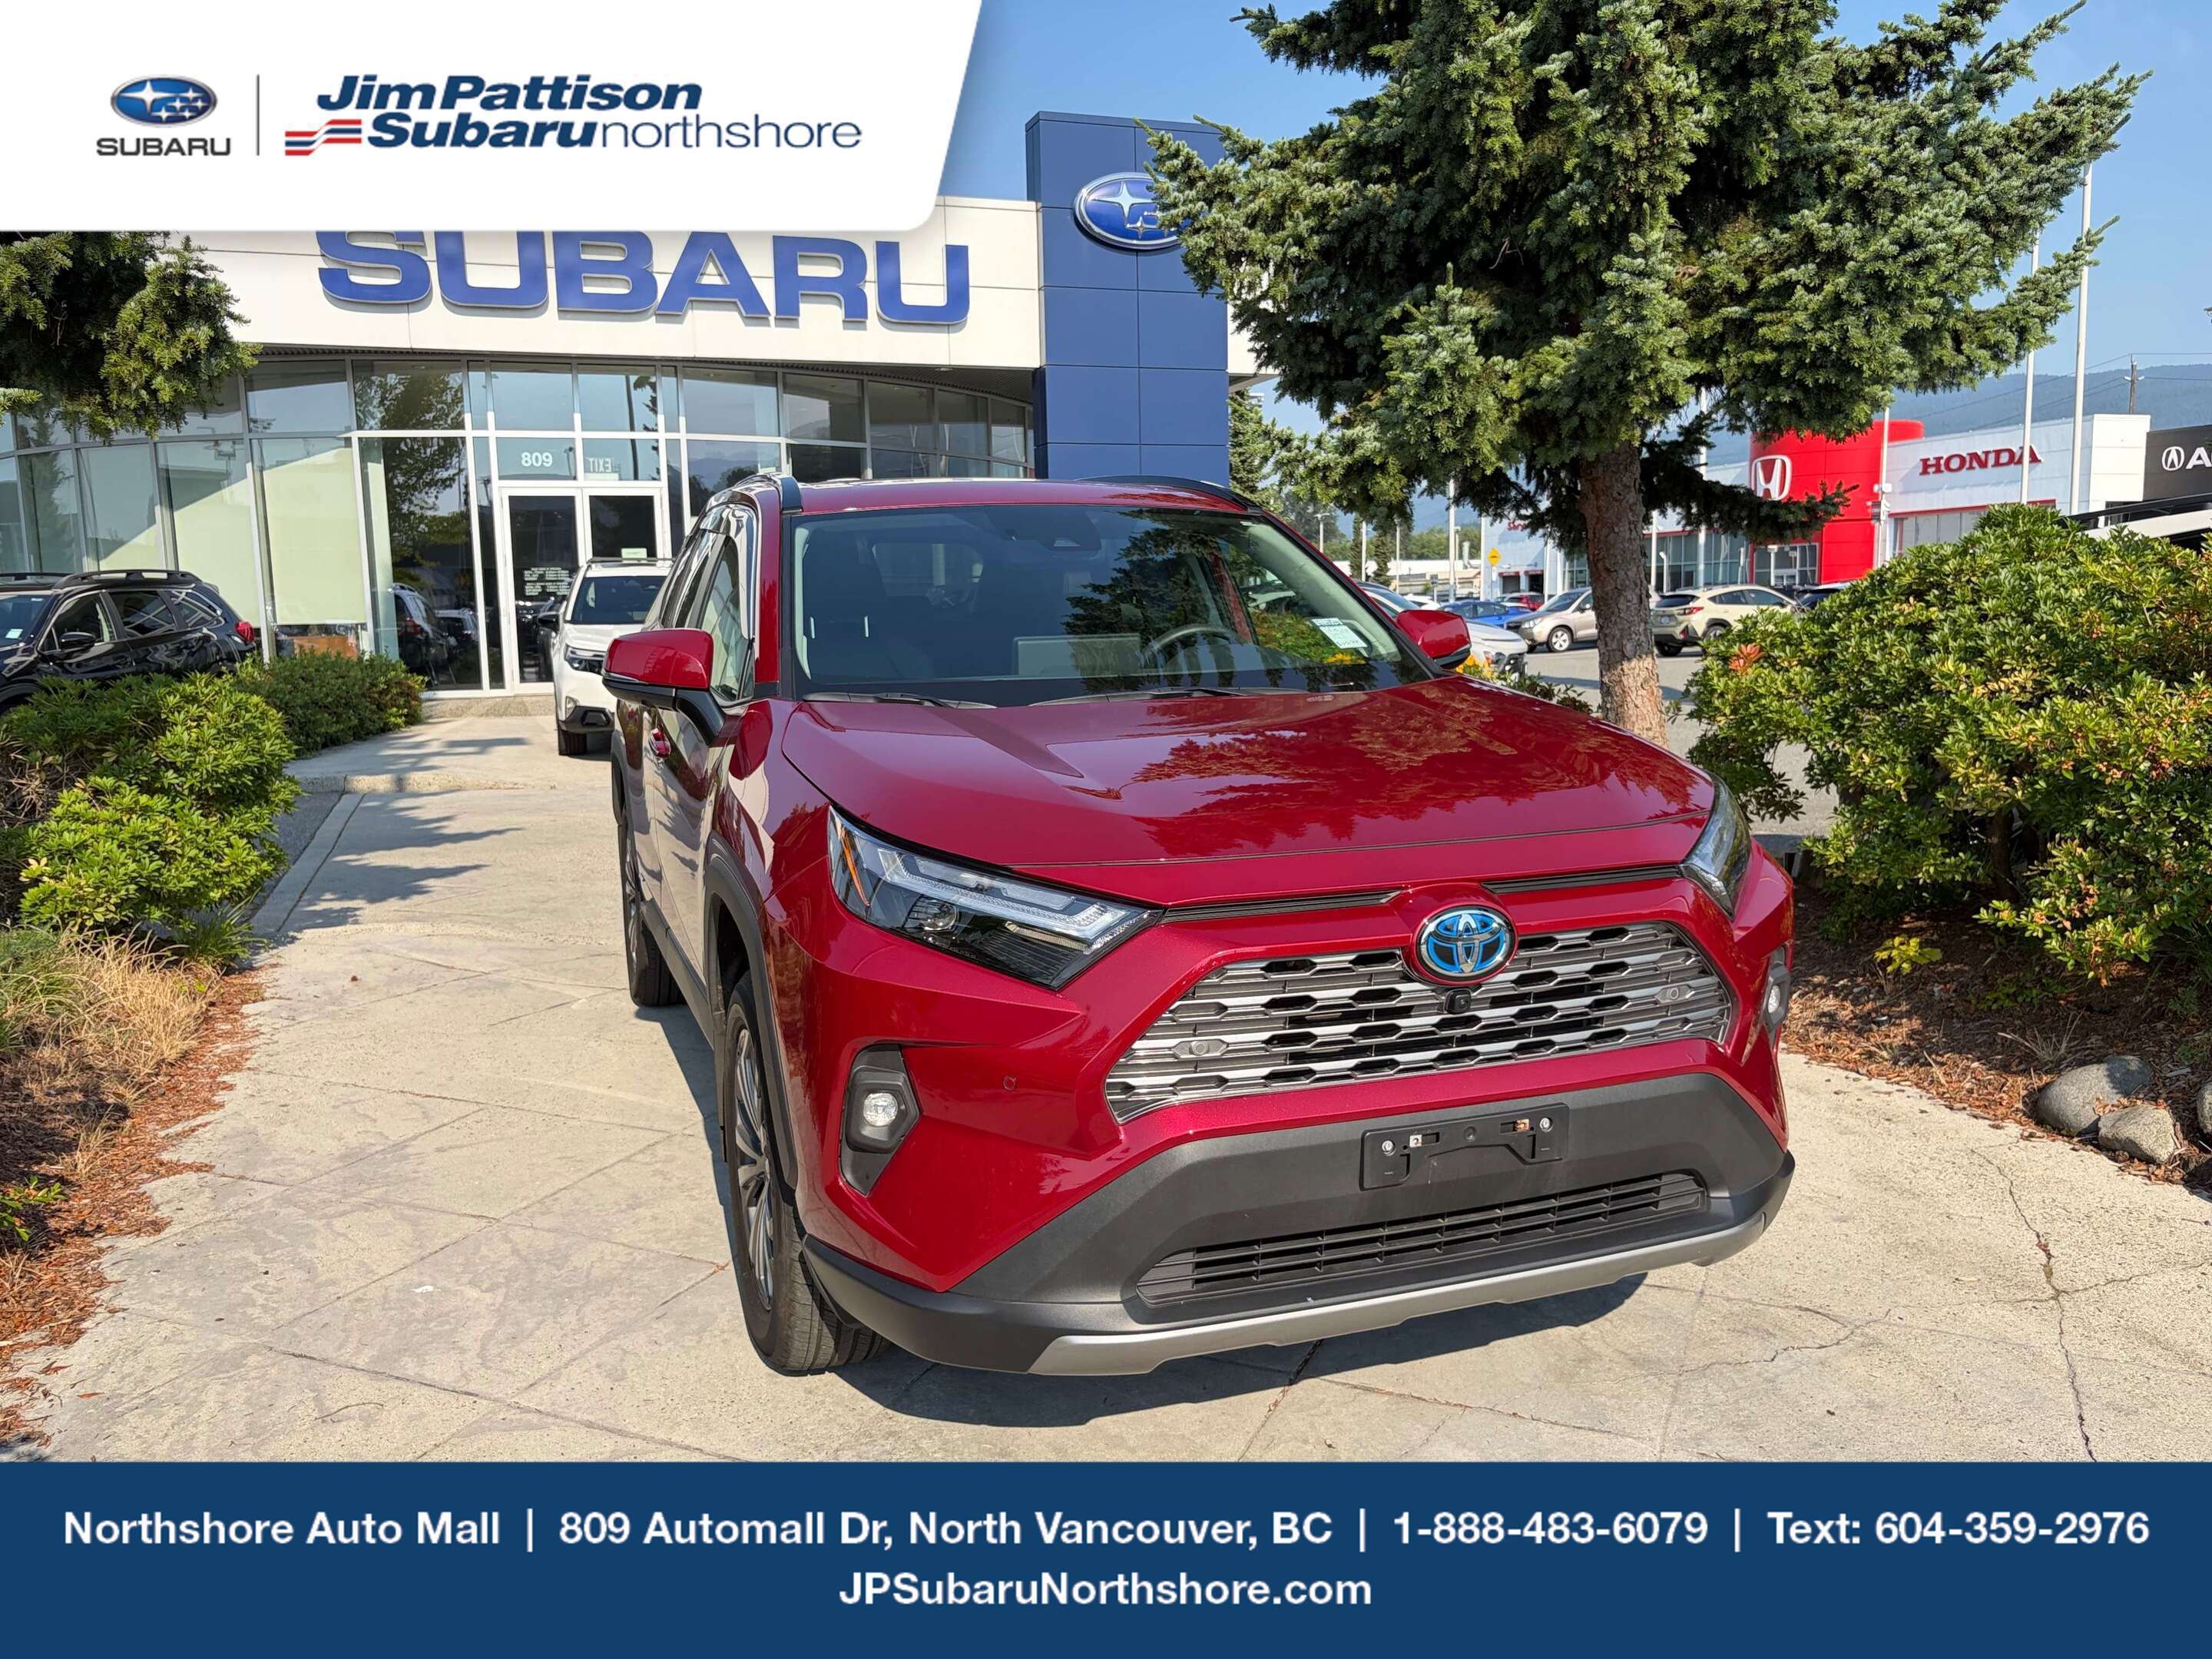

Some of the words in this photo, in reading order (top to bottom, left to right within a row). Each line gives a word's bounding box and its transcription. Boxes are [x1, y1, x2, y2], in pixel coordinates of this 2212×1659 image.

[316, 230, 970, 324] SUBARU
[521, 452, 553, 467] 809
[1919, 445, 2043, 476] HONDA
